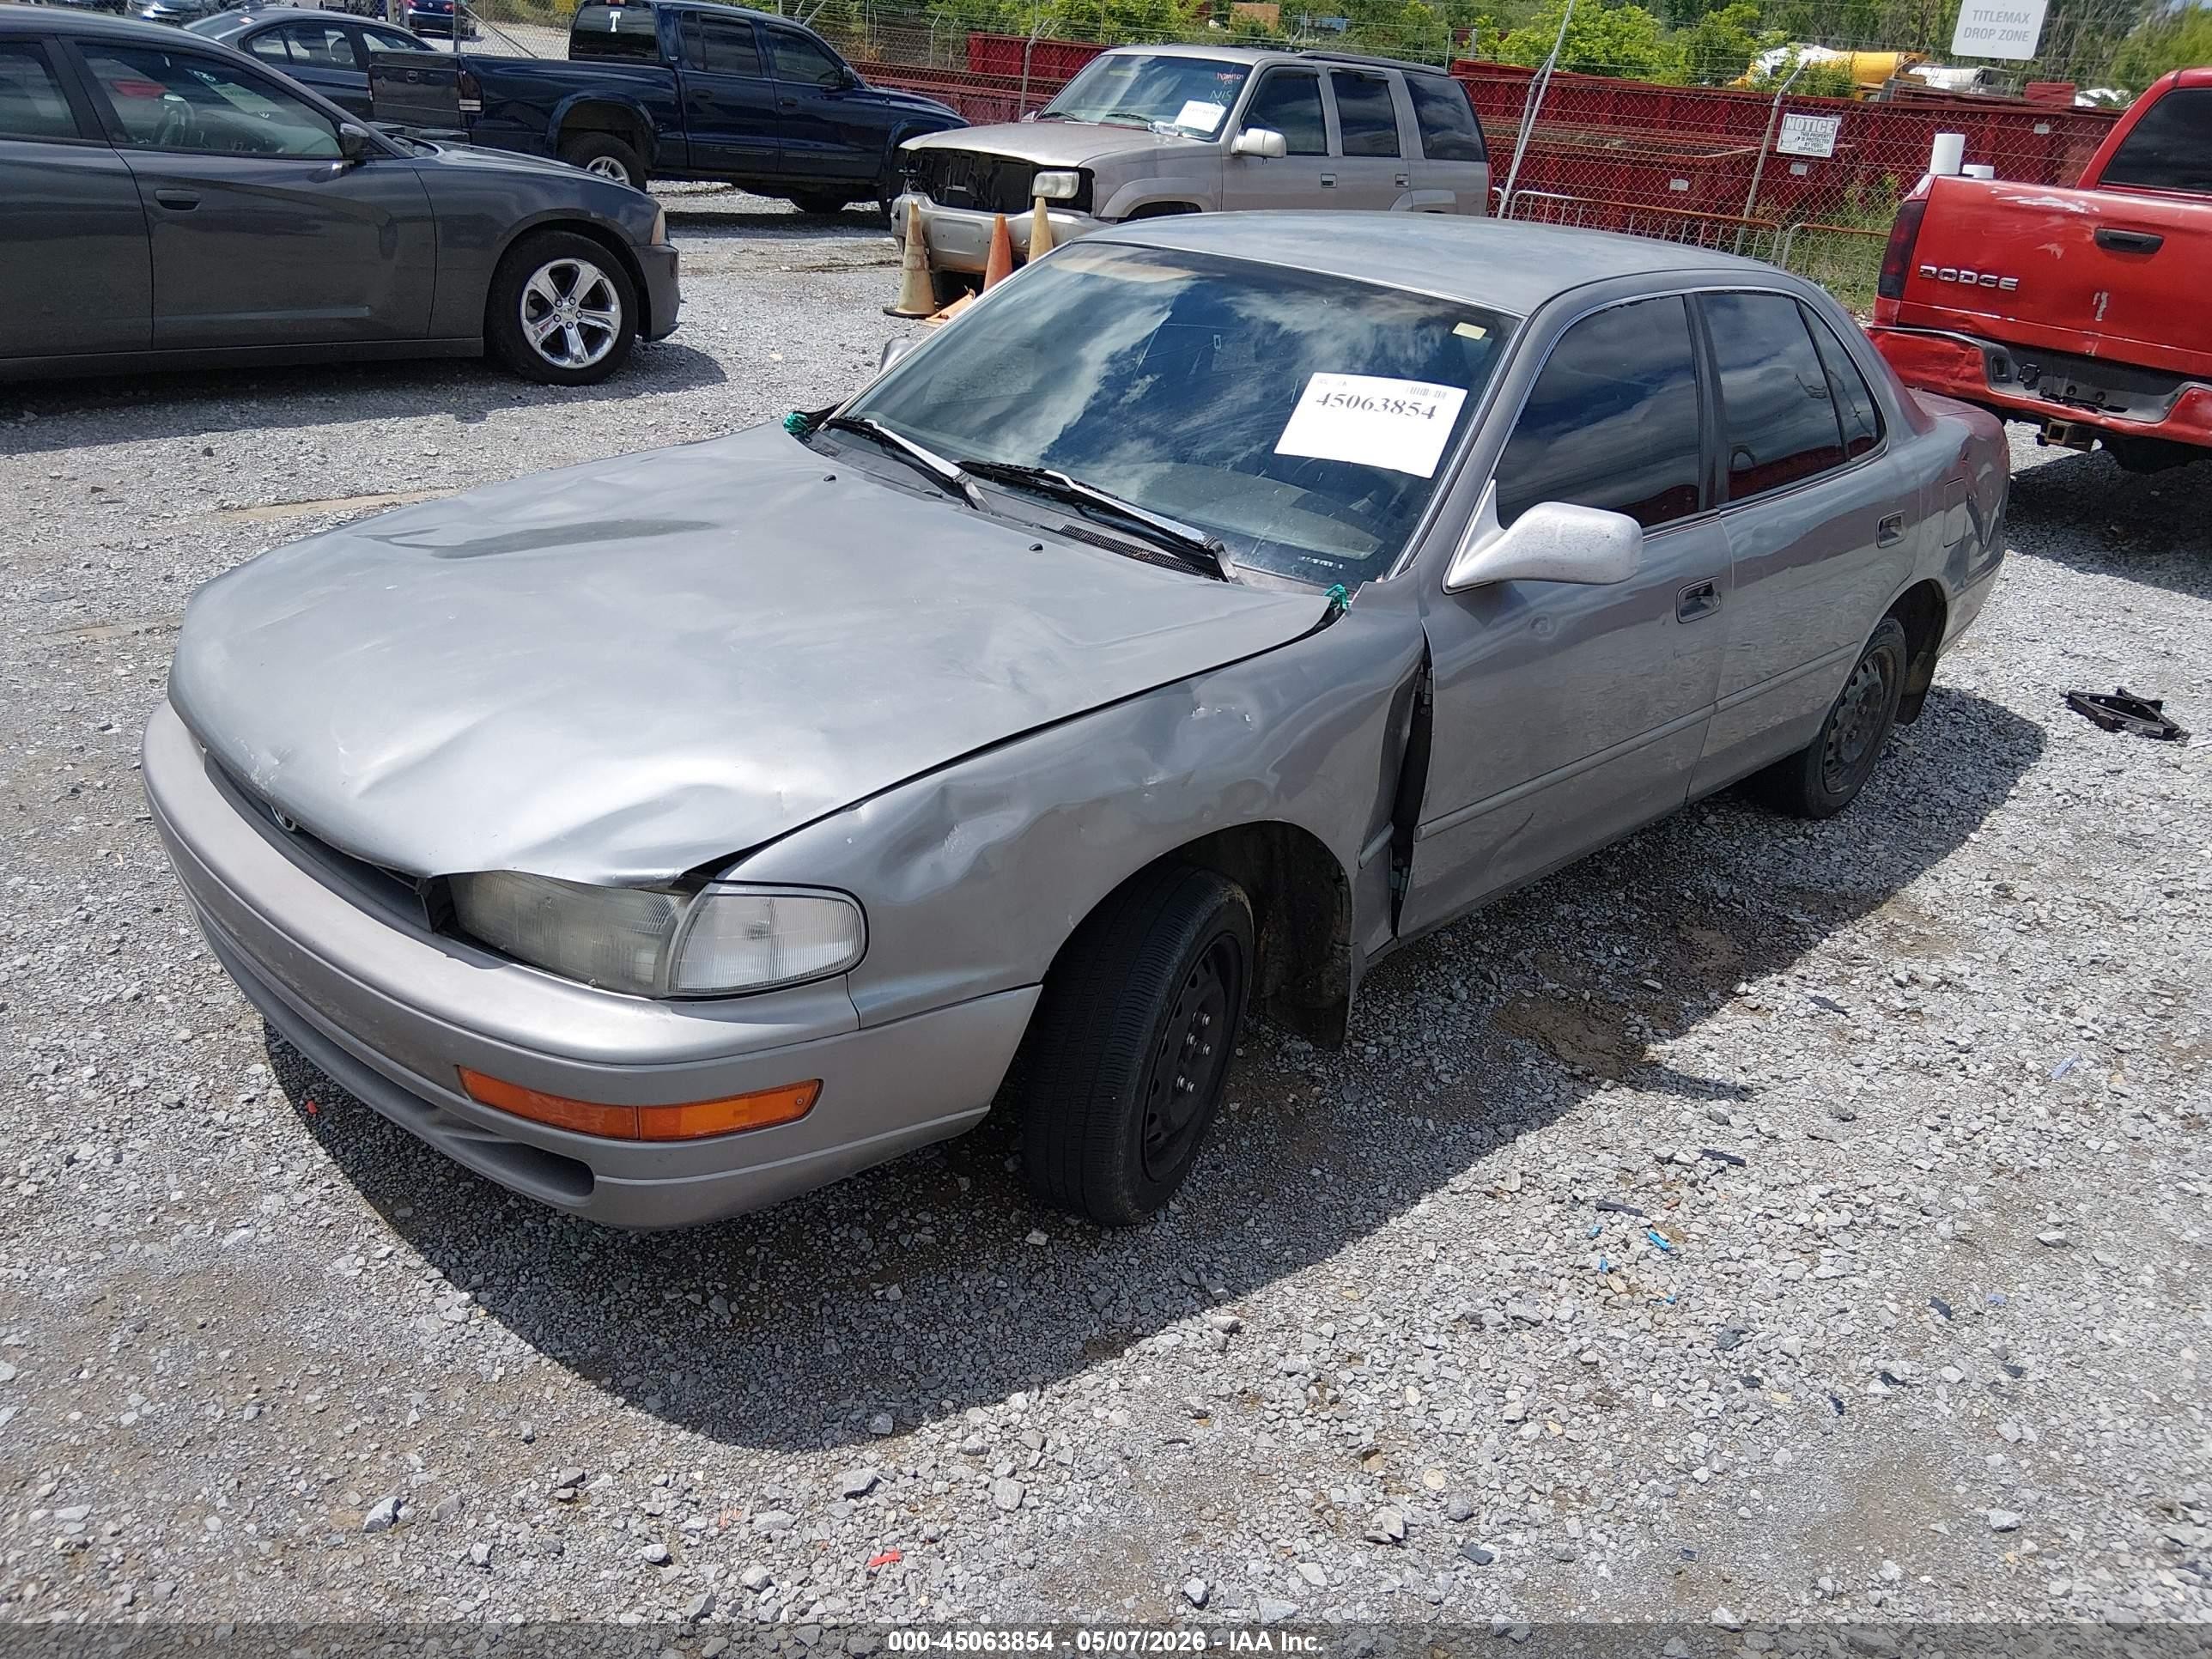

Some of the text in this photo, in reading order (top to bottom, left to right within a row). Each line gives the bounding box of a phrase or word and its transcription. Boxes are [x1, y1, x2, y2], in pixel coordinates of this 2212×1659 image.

[609, 11, 622, 32] T
[1972, 9, 2031, 24] TITLEMAX
[1964, 27, 2030, 42] DROP ZONE
[1785, 117, 1835, 134] NOTICE
[1917, 264, 2020, 292] DODGE
[1316, 392, 1437, 420] 45063854
